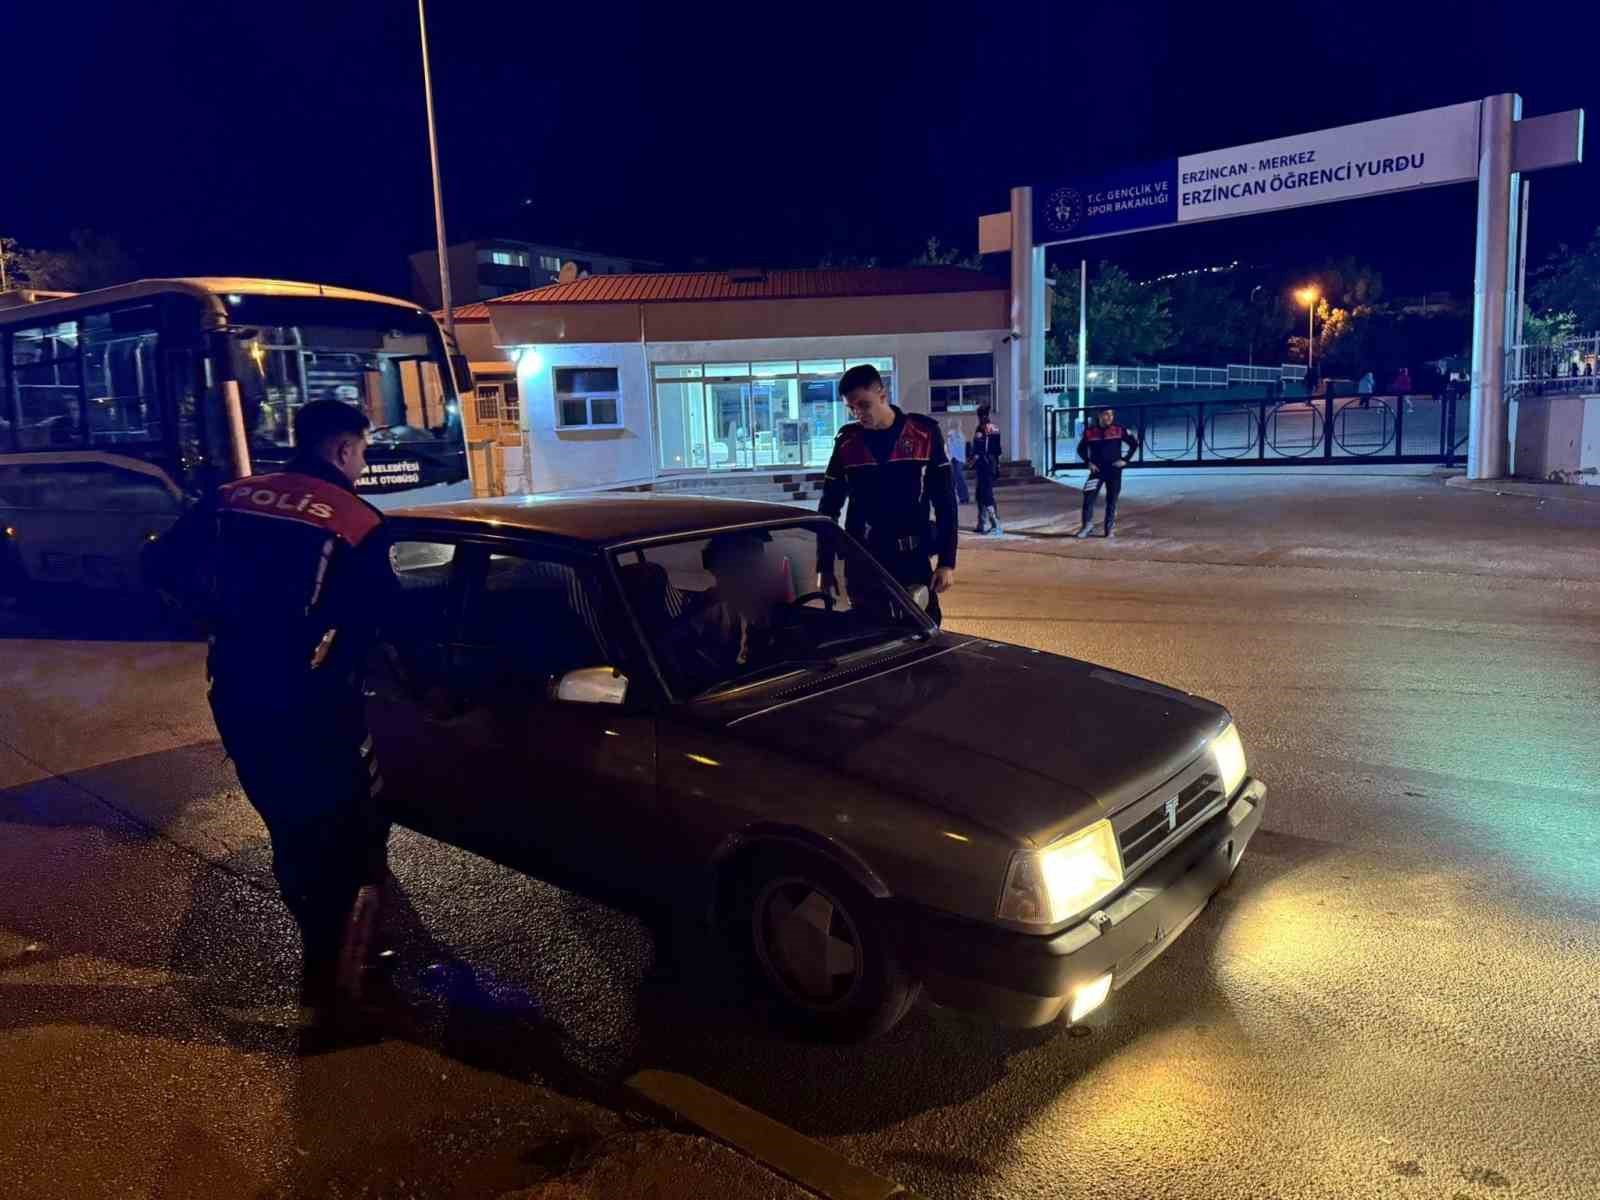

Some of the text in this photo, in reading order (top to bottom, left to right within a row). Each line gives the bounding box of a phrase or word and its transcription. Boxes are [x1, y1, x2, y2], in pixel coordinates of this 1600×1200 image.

[1182, 163, 1247, 184] ERZİNCAN
[1258, 150, 1316, 171] MERKEZ
[1182, 152, 1424, 206] ERZİNCAN ÖĞRENCİ YURDU
[1154, 181, 1168, 192] VE
[1087, 203, 1113, 216] SPOR
[230, 487, 336, 519] POLİS
